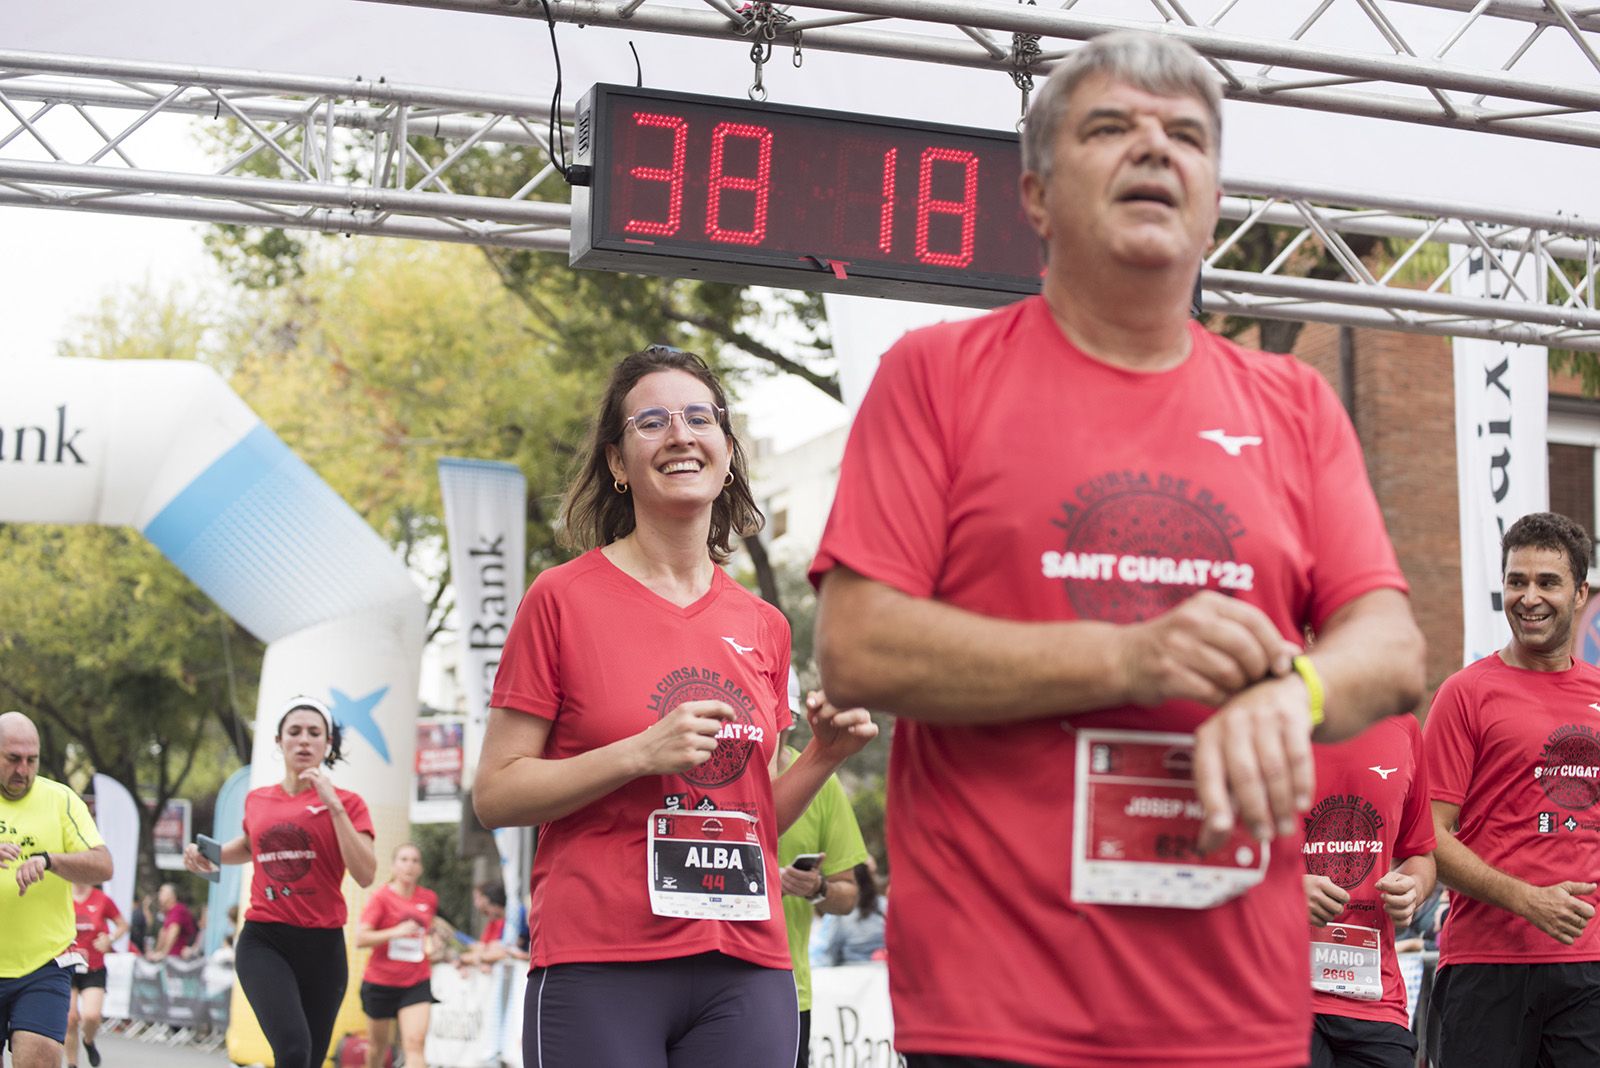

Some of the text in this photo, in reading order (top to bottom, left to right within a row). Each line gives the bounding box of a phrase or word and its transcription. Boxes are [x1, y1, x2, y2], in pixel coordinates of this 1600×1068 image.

[624, 112, 980, 268] 38 18
[0, 404, 87, 464] nk
[1041, 551, 1117, 581] SANT
[647, 692, 662, 711] LA
[656, 666, 699, 693] CURSA
[702, 668, 720, 685] DE
[1310, 795, 1344, 817] CURSA
[1347, 794, 1363, 806] DE
[685, 846, 743, 870] ALBA
[702, 873, 725, 891] 44
[1315, 948, 1364, 967] MARIO
[1323, 968, 1354, 982] 2649
